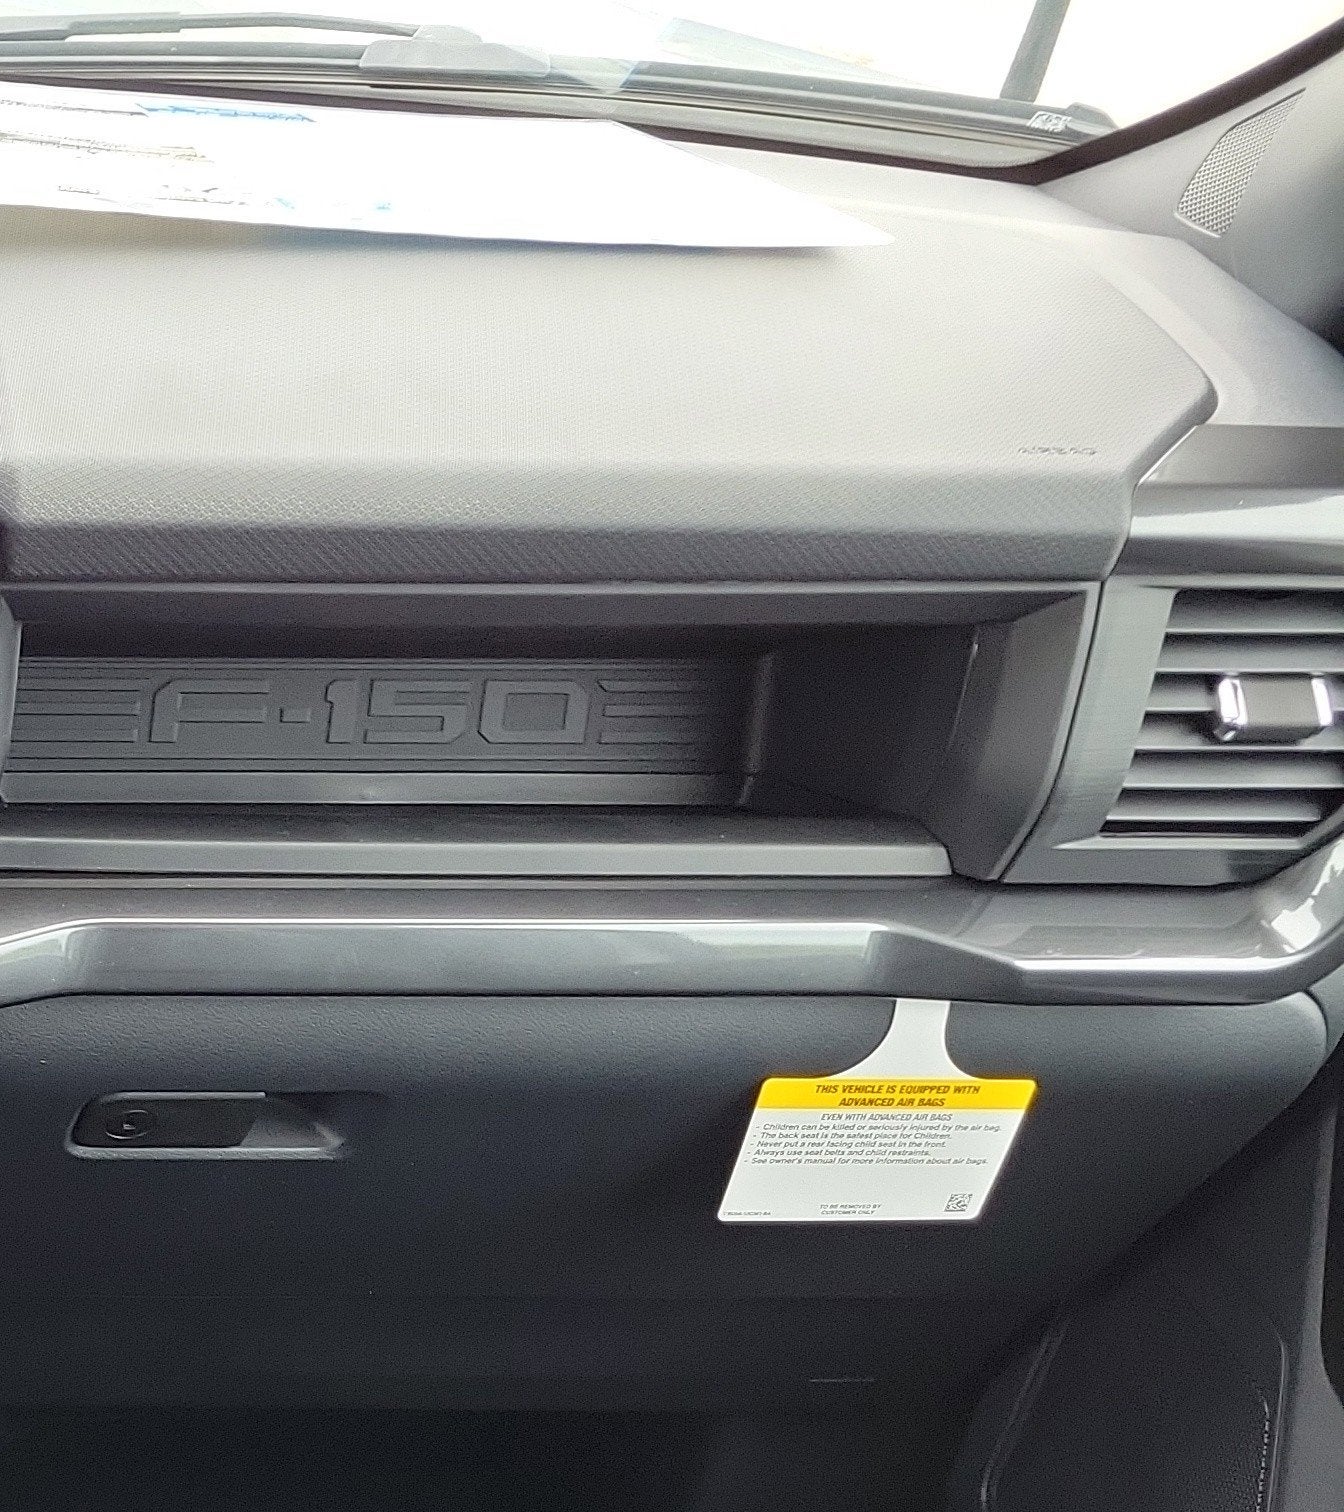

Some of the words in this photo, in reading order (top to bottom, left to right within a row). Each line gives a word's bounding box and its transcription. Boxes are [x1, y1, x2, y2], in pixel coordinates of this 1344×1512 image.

[148, 677, 591, 745] F-150
[815, 1085, 839, 1094] THIS
[842, 1085, 882, 1094] VEHICLE
[885, 1085, 896, 1094] IS
[899, 1085, 950, 1094] EQUIPPED
[953, 1085, 981, 1094] WITH
[839, 1098, 894, 1107] ADVANCED
[896, 1098, 916, 1107] AIR
[918, 1098, 946, 1107] BAGS
[820, 1113, 843, 1121] EVEN
[845, 1113, 867, 1121] WITH
[868, 1113, 912, 1121] ADVANCED
[914, 1113, 928, 1121] AIR
[930, 1113, 953, 1121] BAGS
